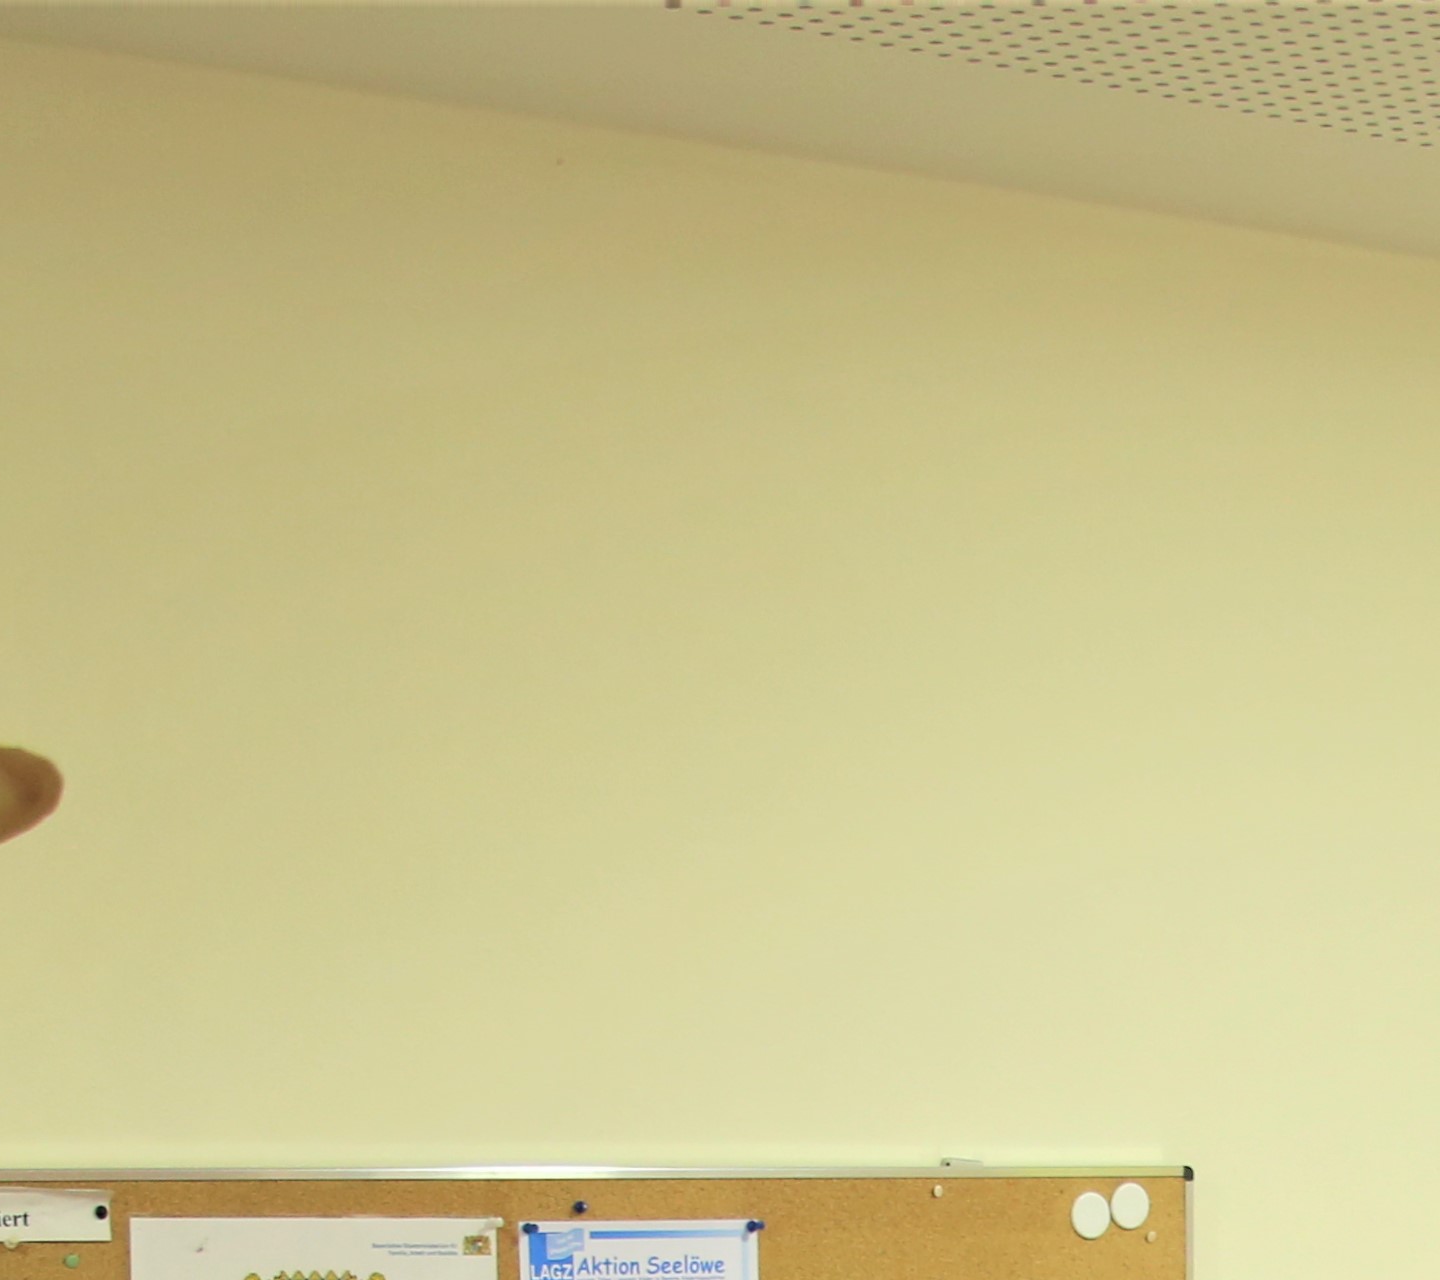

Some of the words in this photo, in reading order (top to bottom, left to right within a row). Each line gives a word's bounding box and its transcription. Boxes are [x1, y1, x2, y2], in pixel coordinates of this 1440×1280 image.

[530, 1264, 573, 1280] LAGZ
[577, 1256, 640, 1275] Aktion
[647, 1255, 725, 1274] Seelöwe
